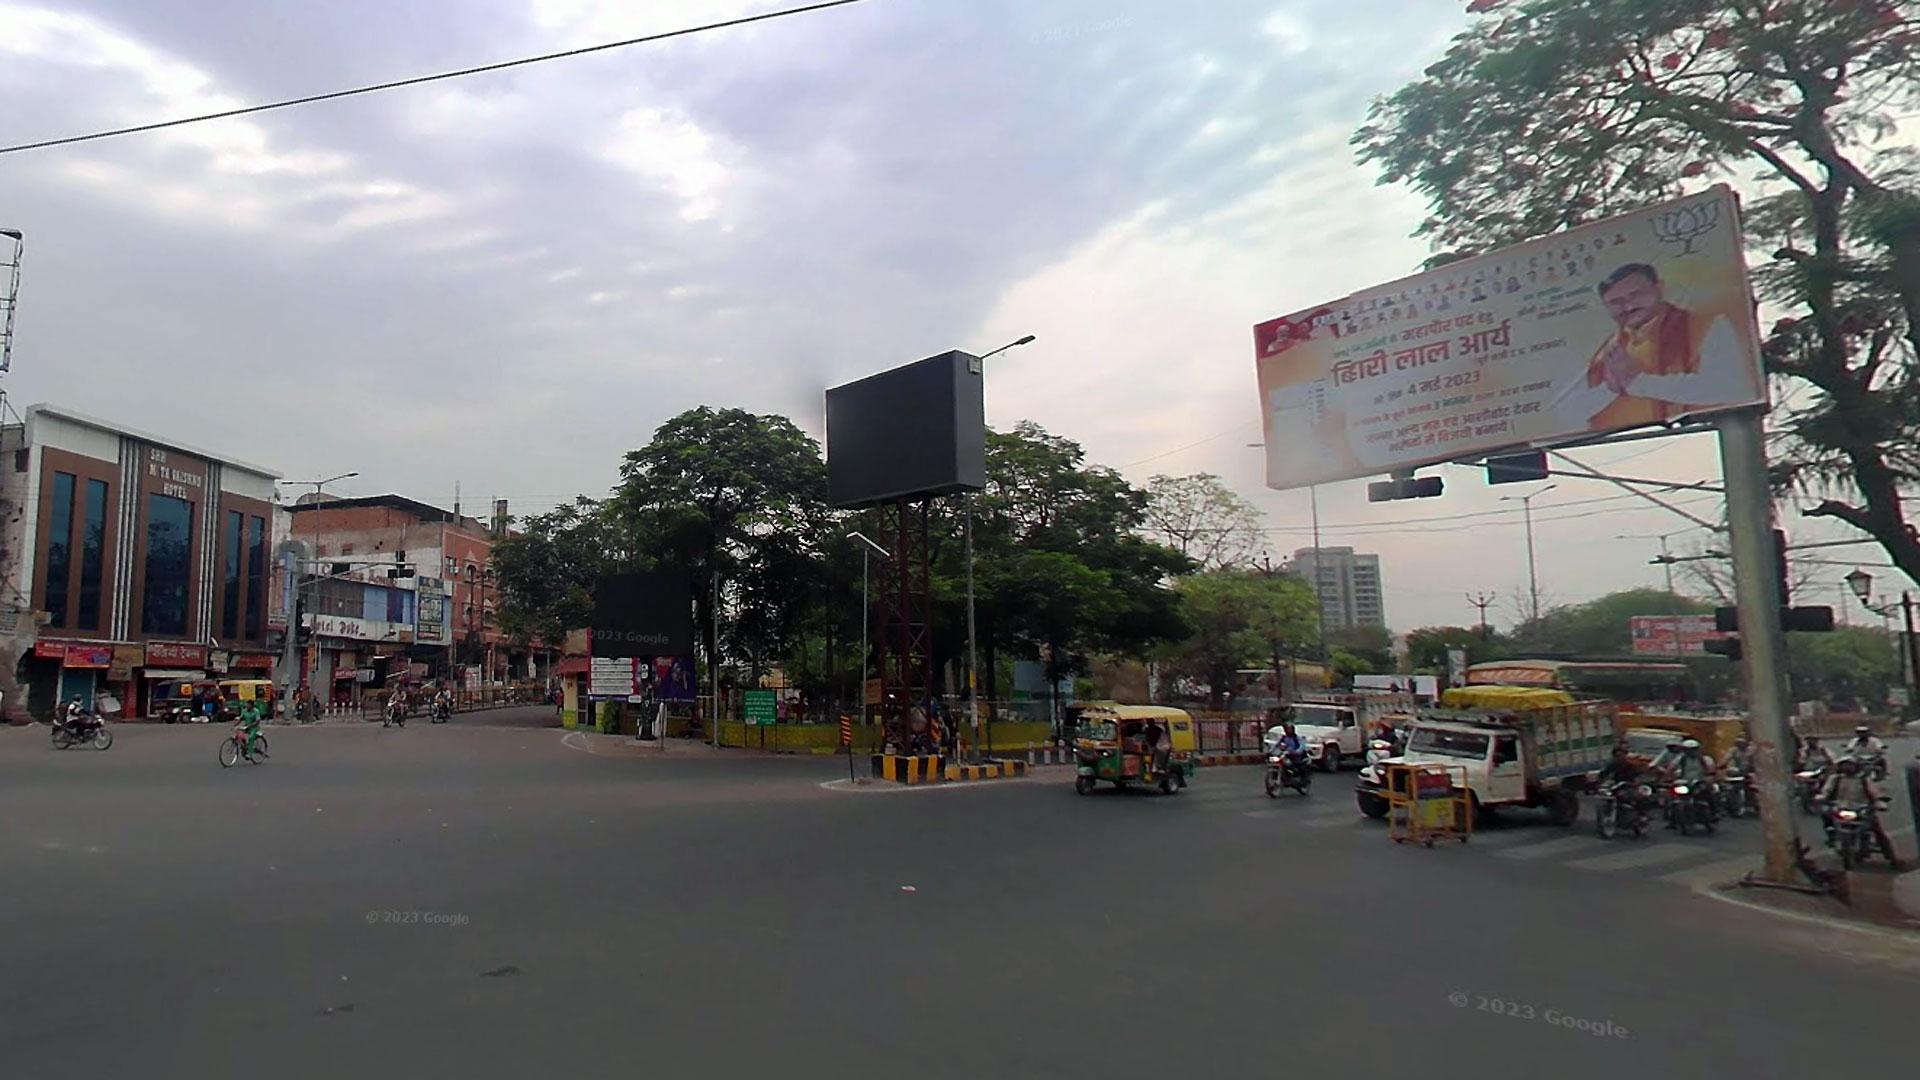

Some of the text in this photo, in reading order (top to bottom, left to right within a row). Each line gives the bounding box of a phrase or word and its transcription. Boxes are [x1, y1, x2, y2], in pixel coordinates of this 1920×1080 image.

[1392, 340, 1452, 371] लाल
[1459, 317, 1512, 357] आर्य
[1408, 369, 1481, 394] 4 मई 2023
[163, 482, 187, 499] HOTEL
